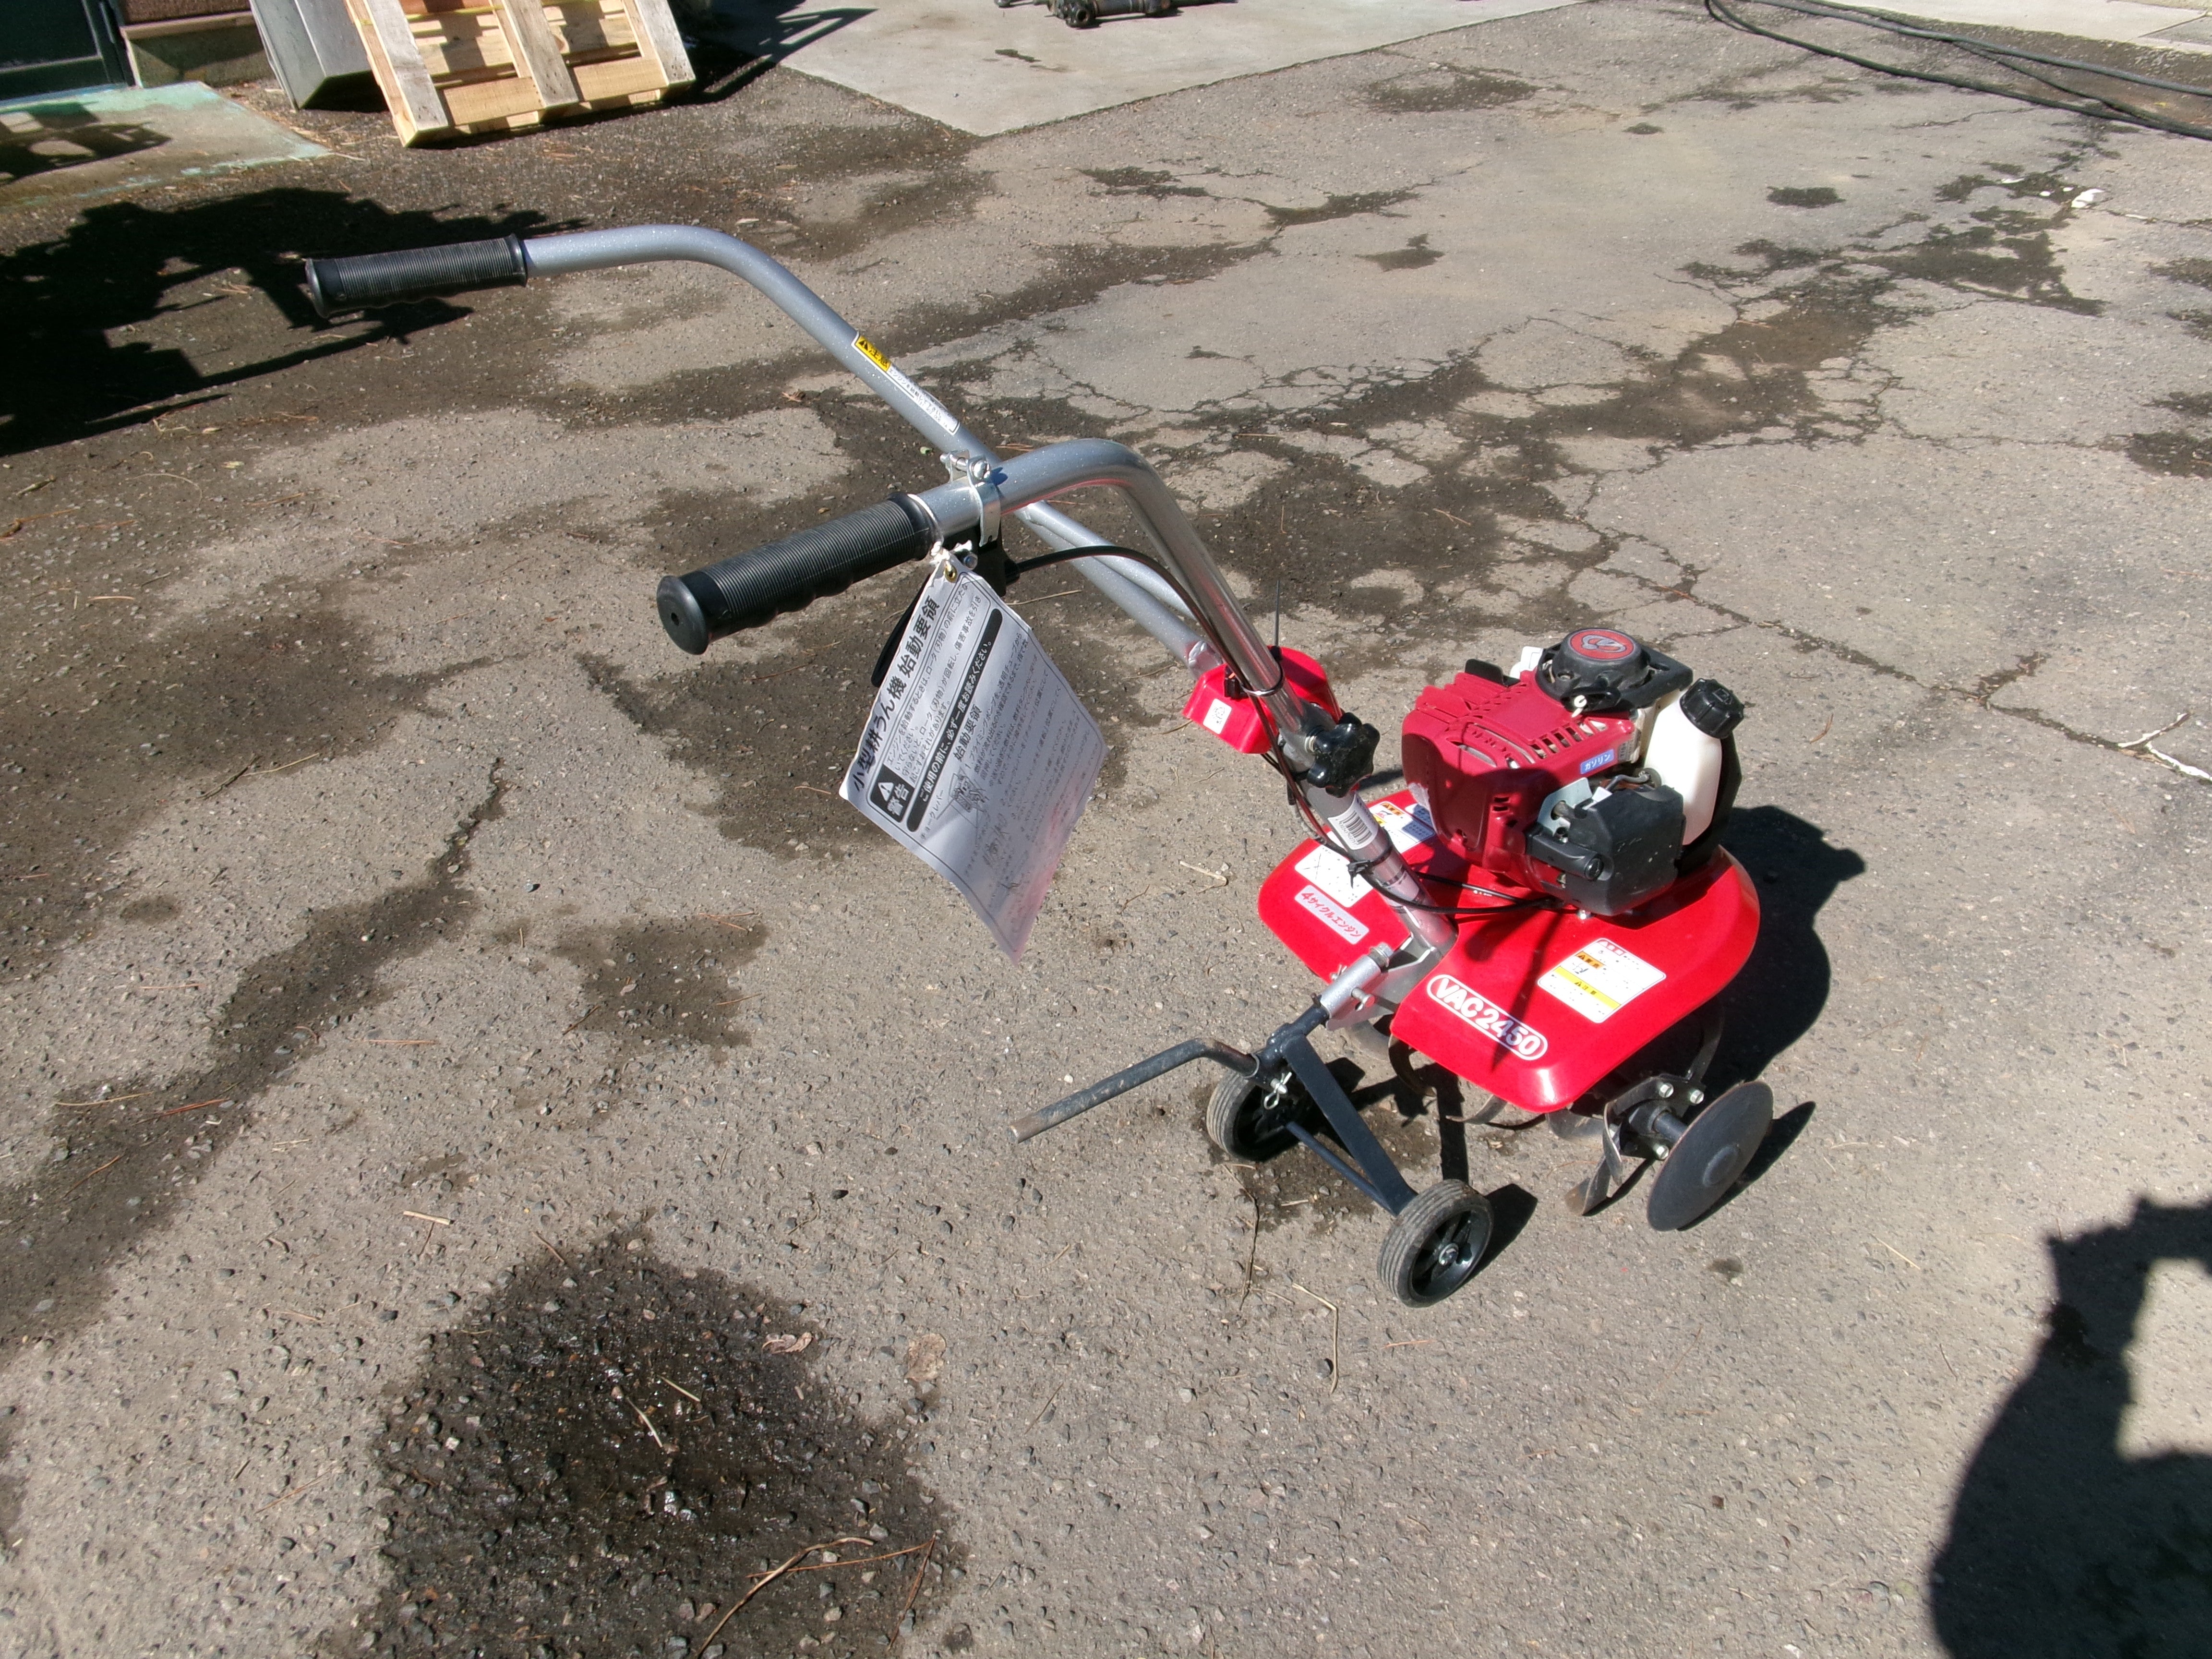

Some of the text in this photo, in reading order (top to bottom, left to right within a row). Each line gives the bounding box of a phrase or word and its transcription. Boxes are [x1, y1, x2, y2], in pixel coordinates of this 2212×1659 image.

[849, 592, 940, 793] 小型耕うん機 始動要領
[919, 636, 992, 804] ご使用の前に、必ず一度お読みください。
[894, 721, 918, 772] いでください。
[952, 702, 982, 763] 始動要領
[1585, 754, 1611, 771] ガソリン
[887, 781, 910, 819] 警告
[1301, 893, 1362, 935] 4サイクルエンジン
[1437, 977, 1540, 1053] VAC2450
